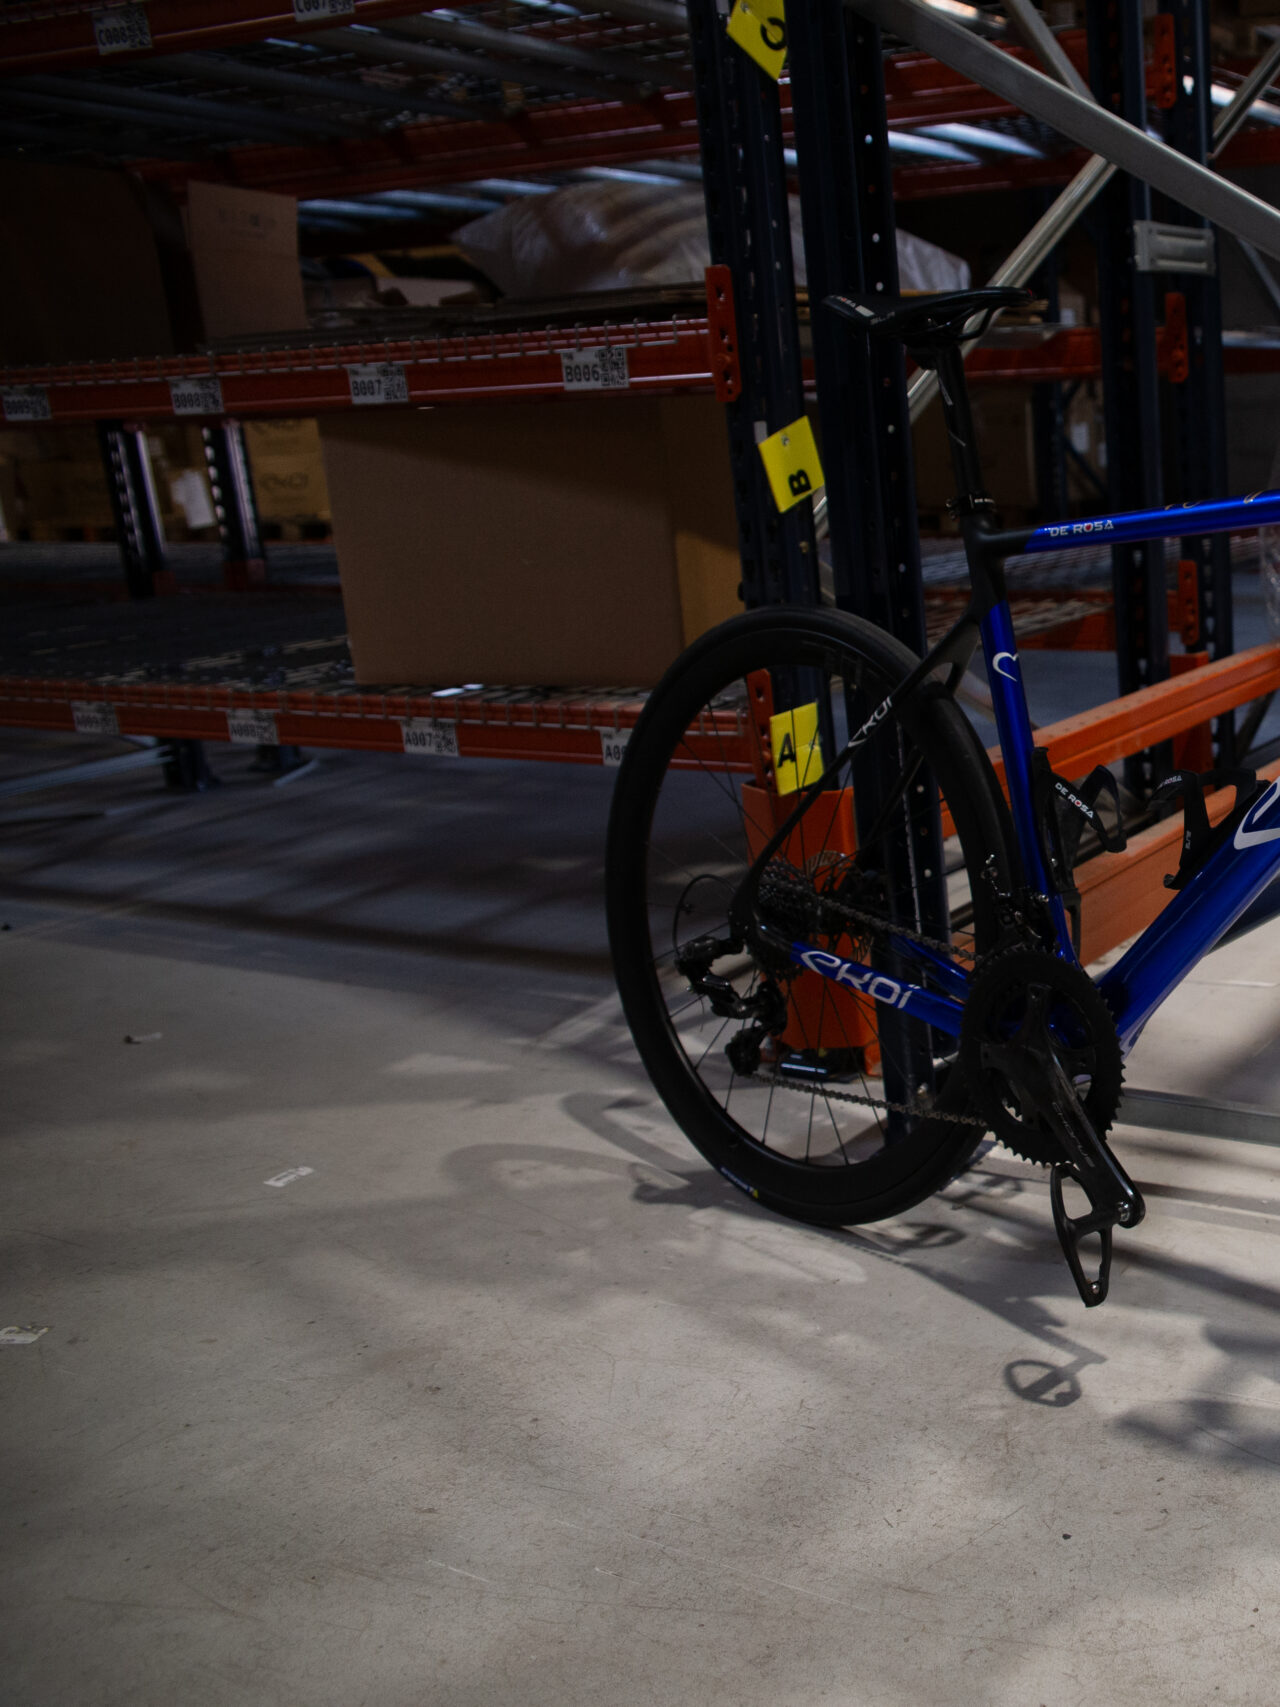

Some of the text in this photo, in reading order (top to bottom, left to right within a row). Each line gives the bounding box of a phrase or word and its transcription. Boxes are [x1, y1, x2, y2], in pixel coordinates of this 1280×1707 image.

[761, 17, 786, 50] C
[565, 364, 600, 383] B006
[352, 379, 382, 397] B007
[789, 469, 812, 496] B
[1050, 519, 1115, 538] DE ROSA
[405, 731, 432, 747] A007
[778, 732, 796, 768] A
[1054, 781, 1095, 819] DE ROSA
